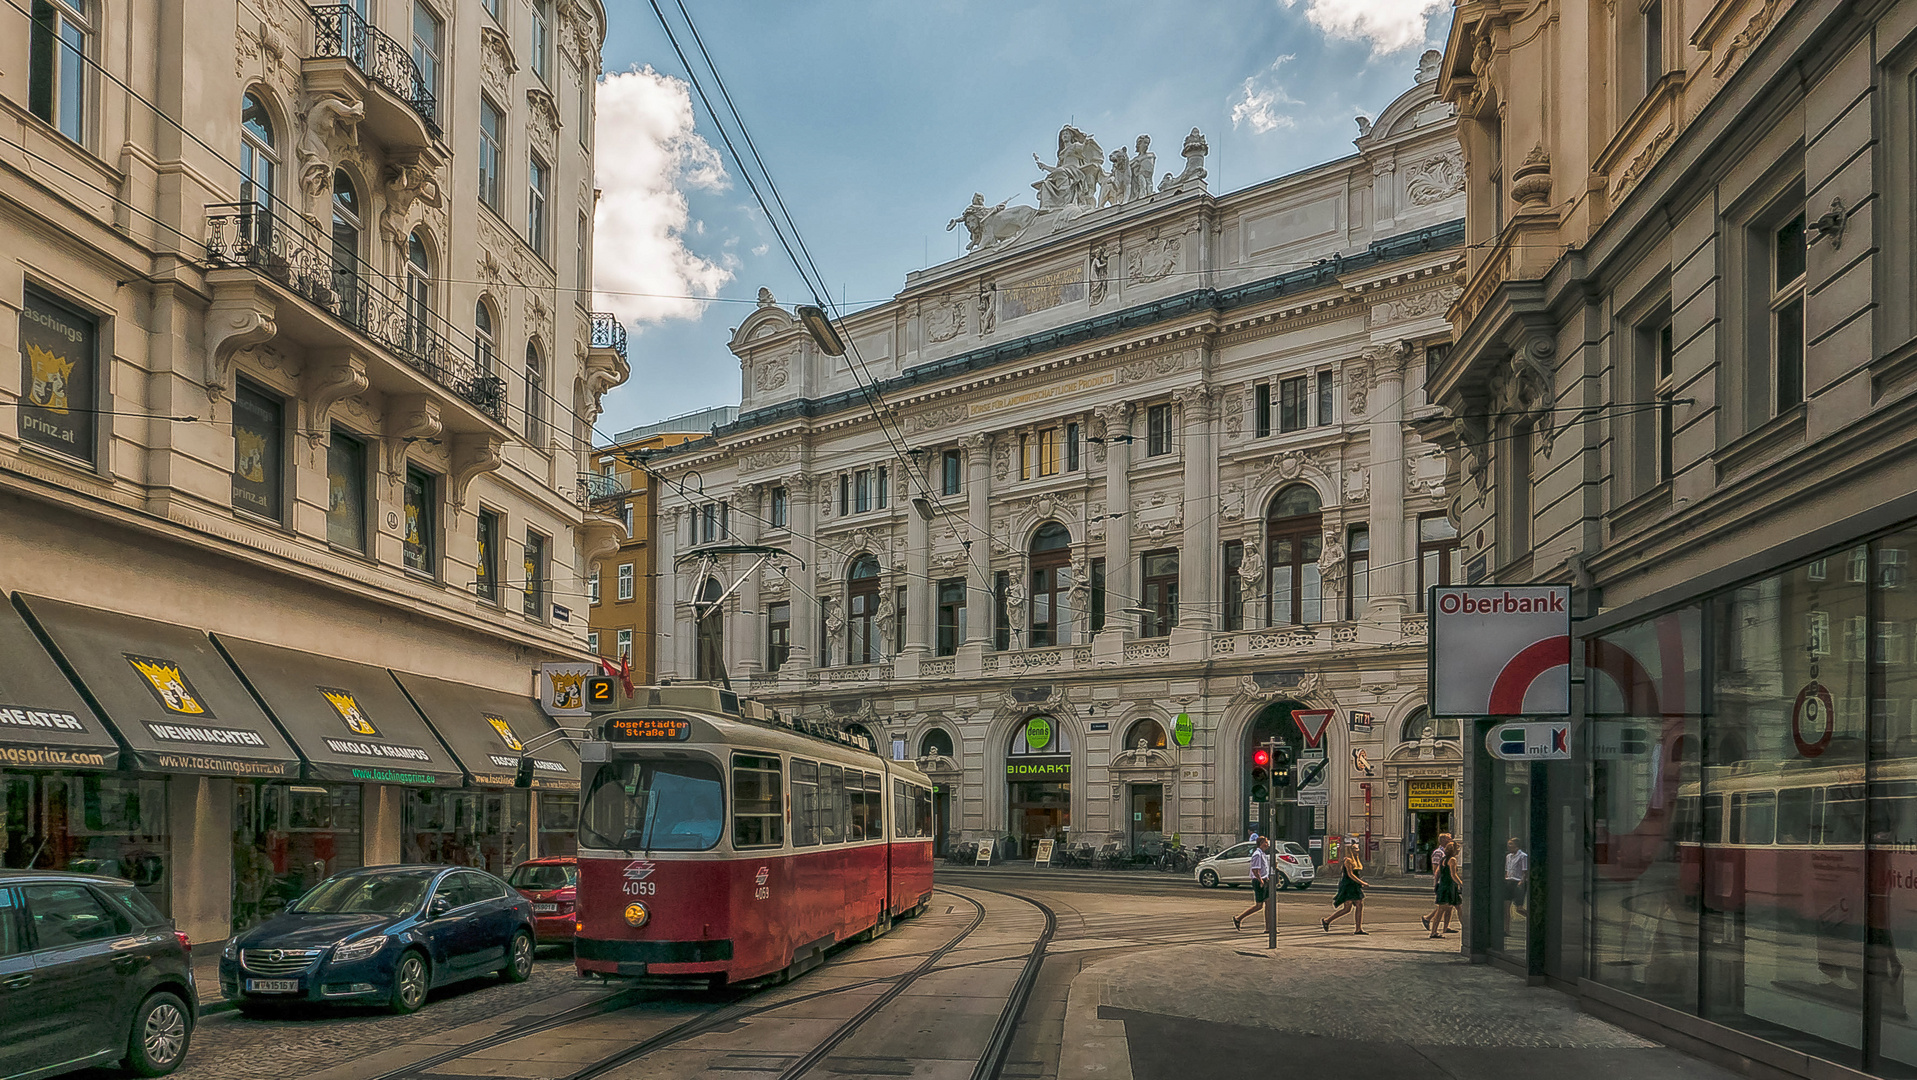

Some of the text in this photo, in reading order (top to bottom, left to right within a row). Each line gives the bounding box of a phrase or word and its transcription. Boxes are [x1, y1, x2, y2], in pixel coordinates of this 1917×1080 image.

[23, 415, 75, 443] prinz.at
[232, 486, 267, 507] prinz.at
[1439, 590, 1565, 614] Oberbank
[595, 682, 609, 699] 2
[613, 720, 688, 729] Josefstädter
[1354, 712, 1364, 724] FIT
[149, 723, 265, 746] WEIHNACHTEN
[626, 728, 665, 737] Straße
[327, 739, 430, 761] NIKOLO & KRAMPUS
[1529, 744, 1549, 754] mit
[352, 768, 436, 784] www.faschingsprinz.eu
[1006, 764, 1071, 774] BIOMARKT
[1411, 782, 1453, 790] CIGARREN
[622, 881, 656, 896] 4059
[755, 886, 770, 900] 4059
